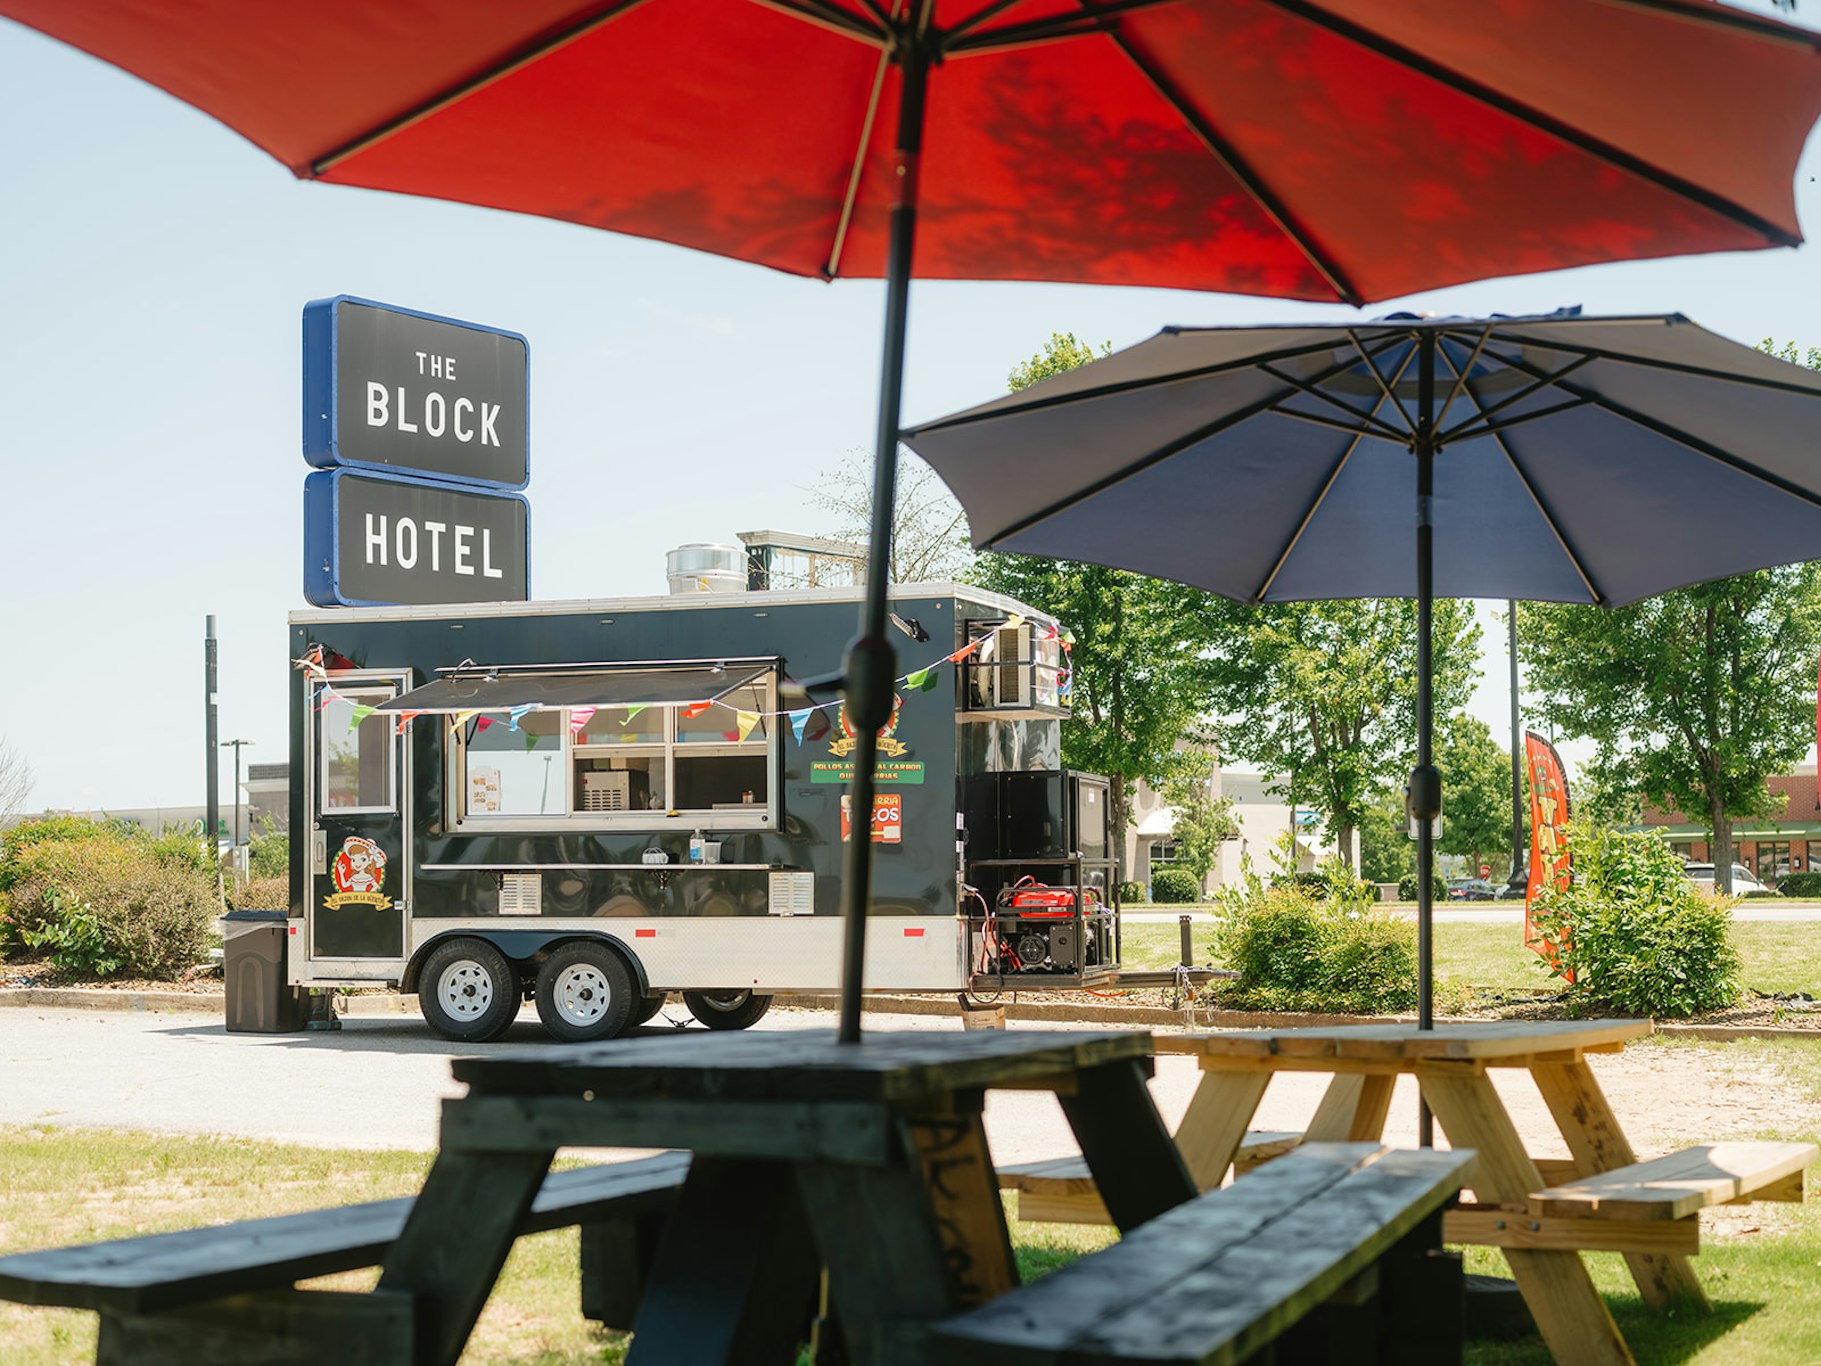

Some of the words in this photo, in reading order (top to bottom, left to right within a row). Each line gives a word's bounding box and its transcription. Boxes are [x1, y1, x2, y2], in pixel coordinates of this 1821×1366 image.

[416, 351, 456, 381] THE
[367, 381, 501, 448] BLOCK
[365, 513, 503, 578] HOTEL
[877, 763, 887, 771] AL
[842, 807, 899, 823] TOS
